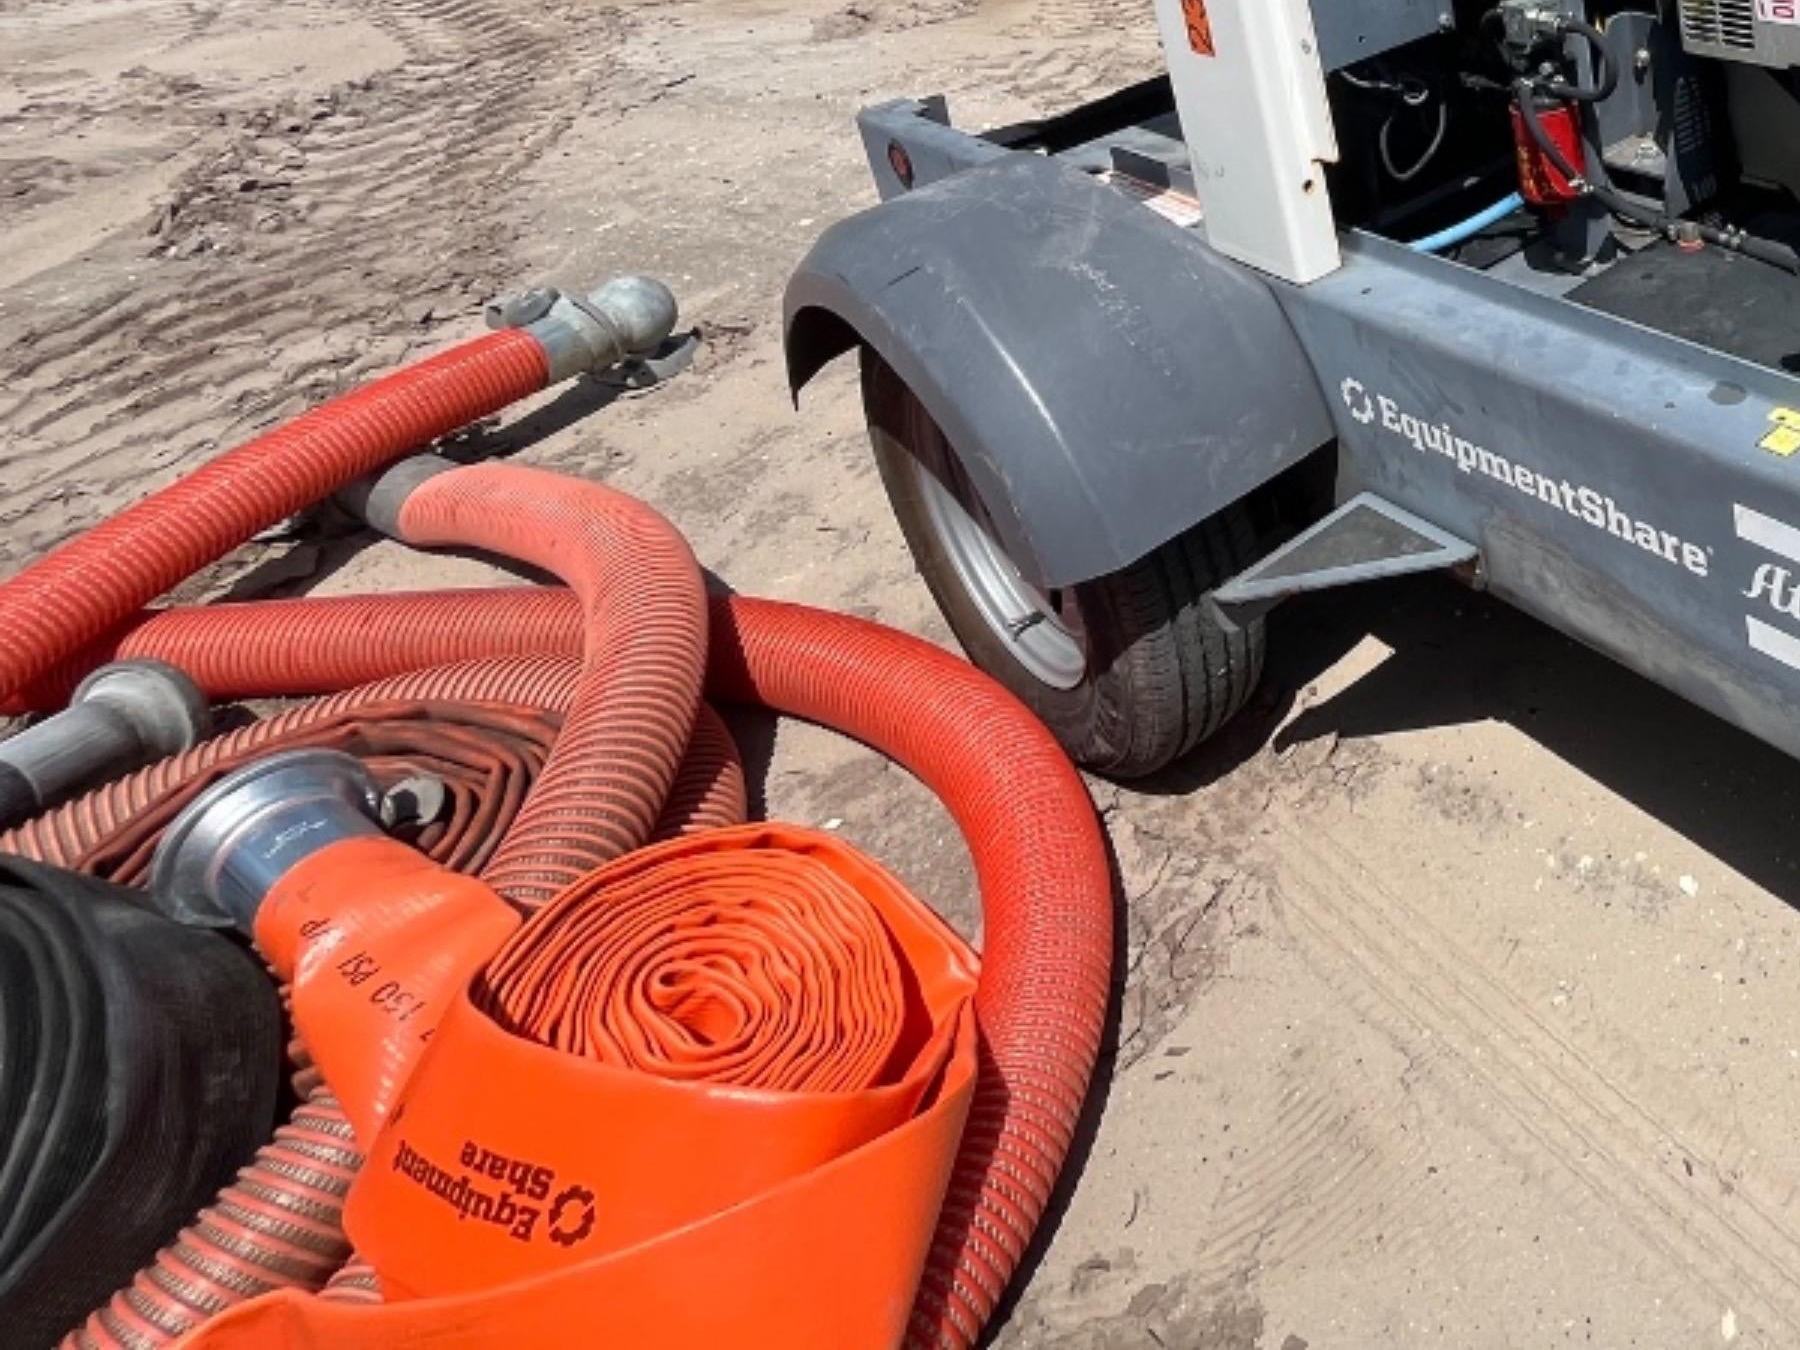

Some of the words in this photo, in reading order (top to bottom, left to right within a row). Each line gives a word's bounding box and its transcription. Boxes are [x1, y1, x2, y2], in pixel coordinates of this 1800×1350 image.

[1376, 394, 1709, 578] EquipmentShare
[336, 950, 381, 987] PSI
[392, 1139, 541, 1243] Equipment
[459, 1140, 556, 1201] Share
